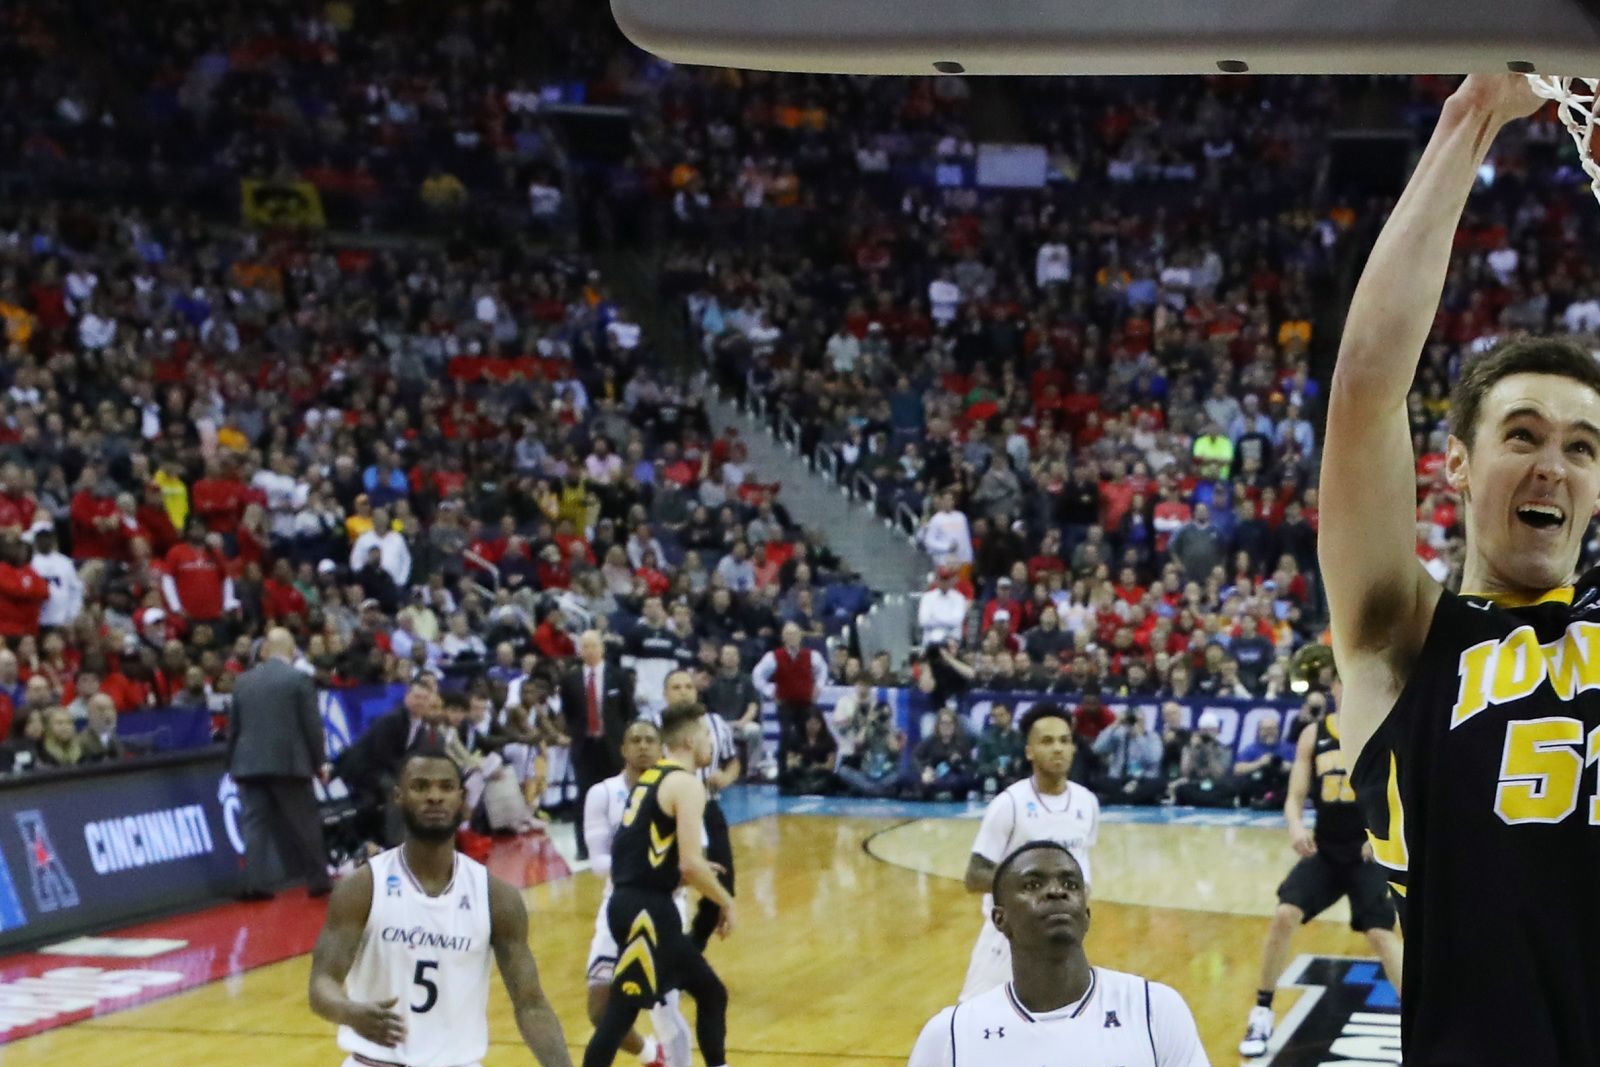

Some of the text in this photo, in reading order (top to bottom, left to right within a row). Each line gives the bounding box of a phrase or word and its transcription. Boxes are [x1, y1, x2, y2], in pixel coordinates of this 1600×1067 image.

[84, 804, 213, 875] CINCINNATI
[381, 927, 472, 951] CINCINNATI
[410, 959, 439, 1013] 5
